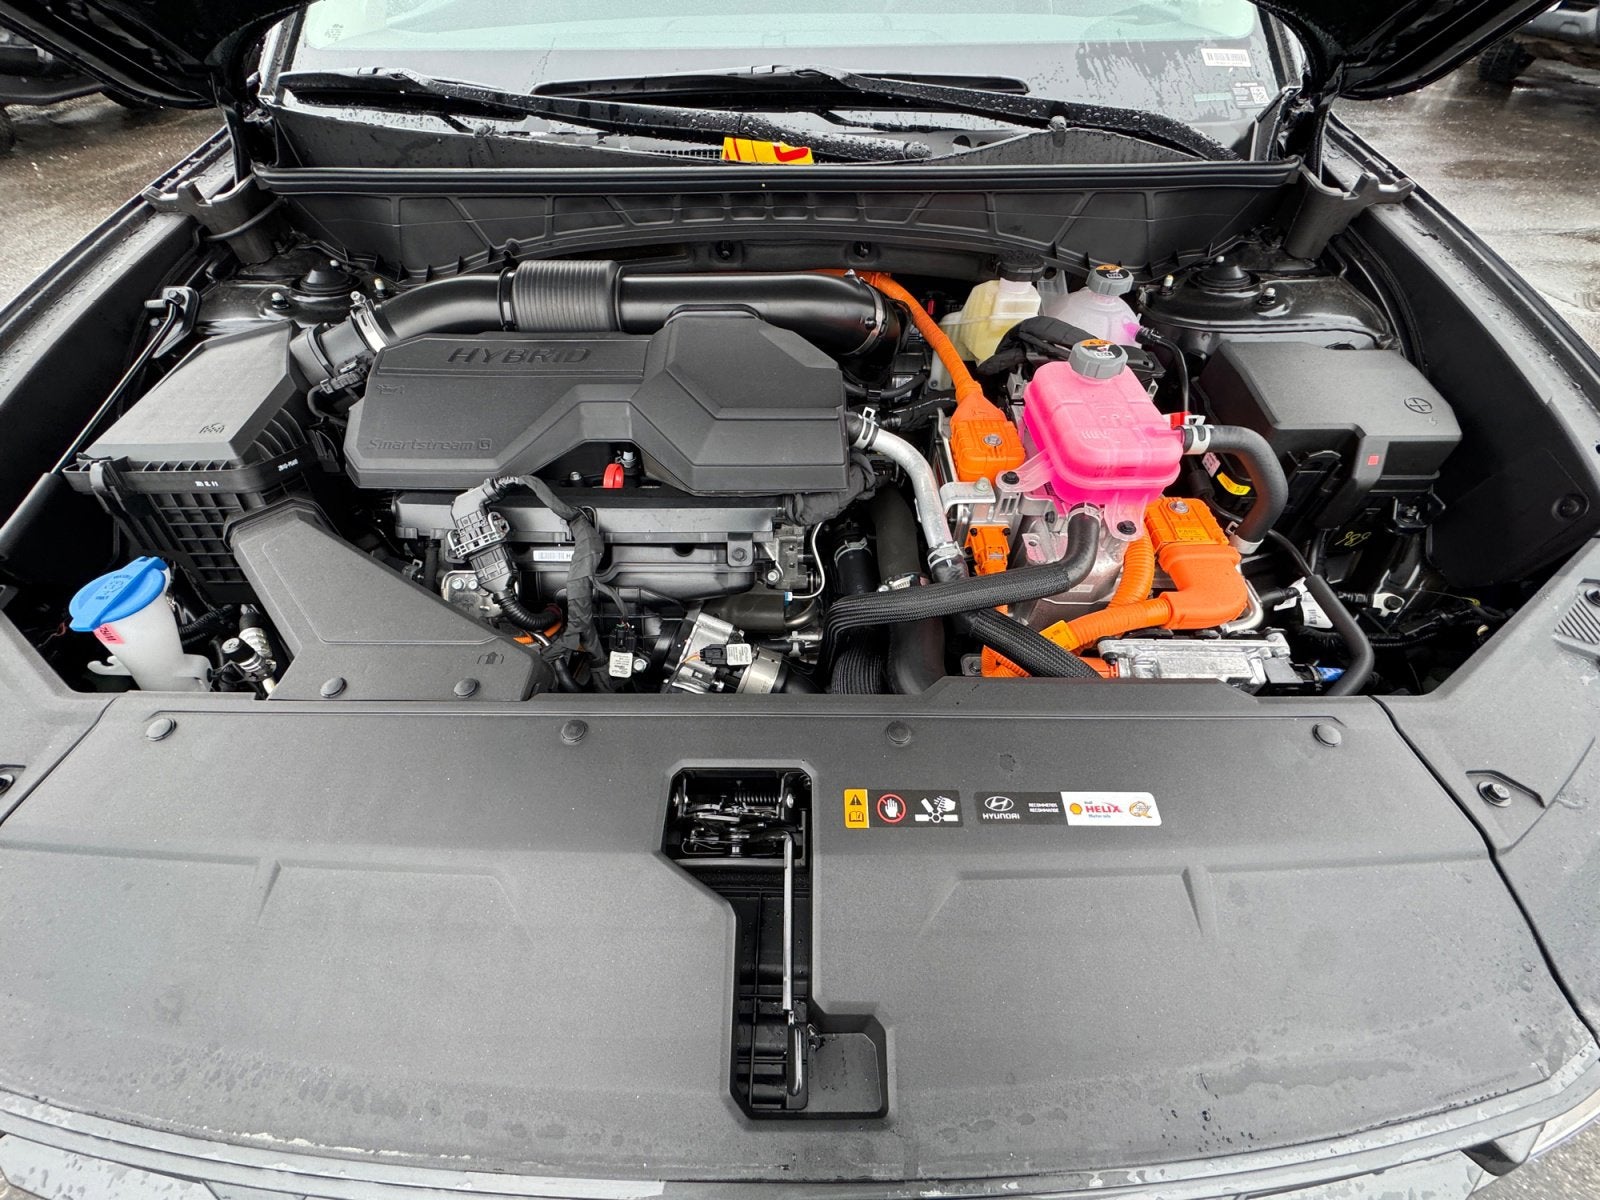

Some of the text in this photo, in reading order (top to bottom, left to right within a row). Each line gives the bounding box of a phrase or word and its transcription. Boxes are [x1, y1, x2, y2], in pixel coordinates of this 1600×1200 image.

[447, 347, 592, 364] HYBRID
[368, 438, 475, 451] Smartstream
[1085, 805, 1122, 814] HELIX
[982, 812, 1020, 820] HYUNDAI
